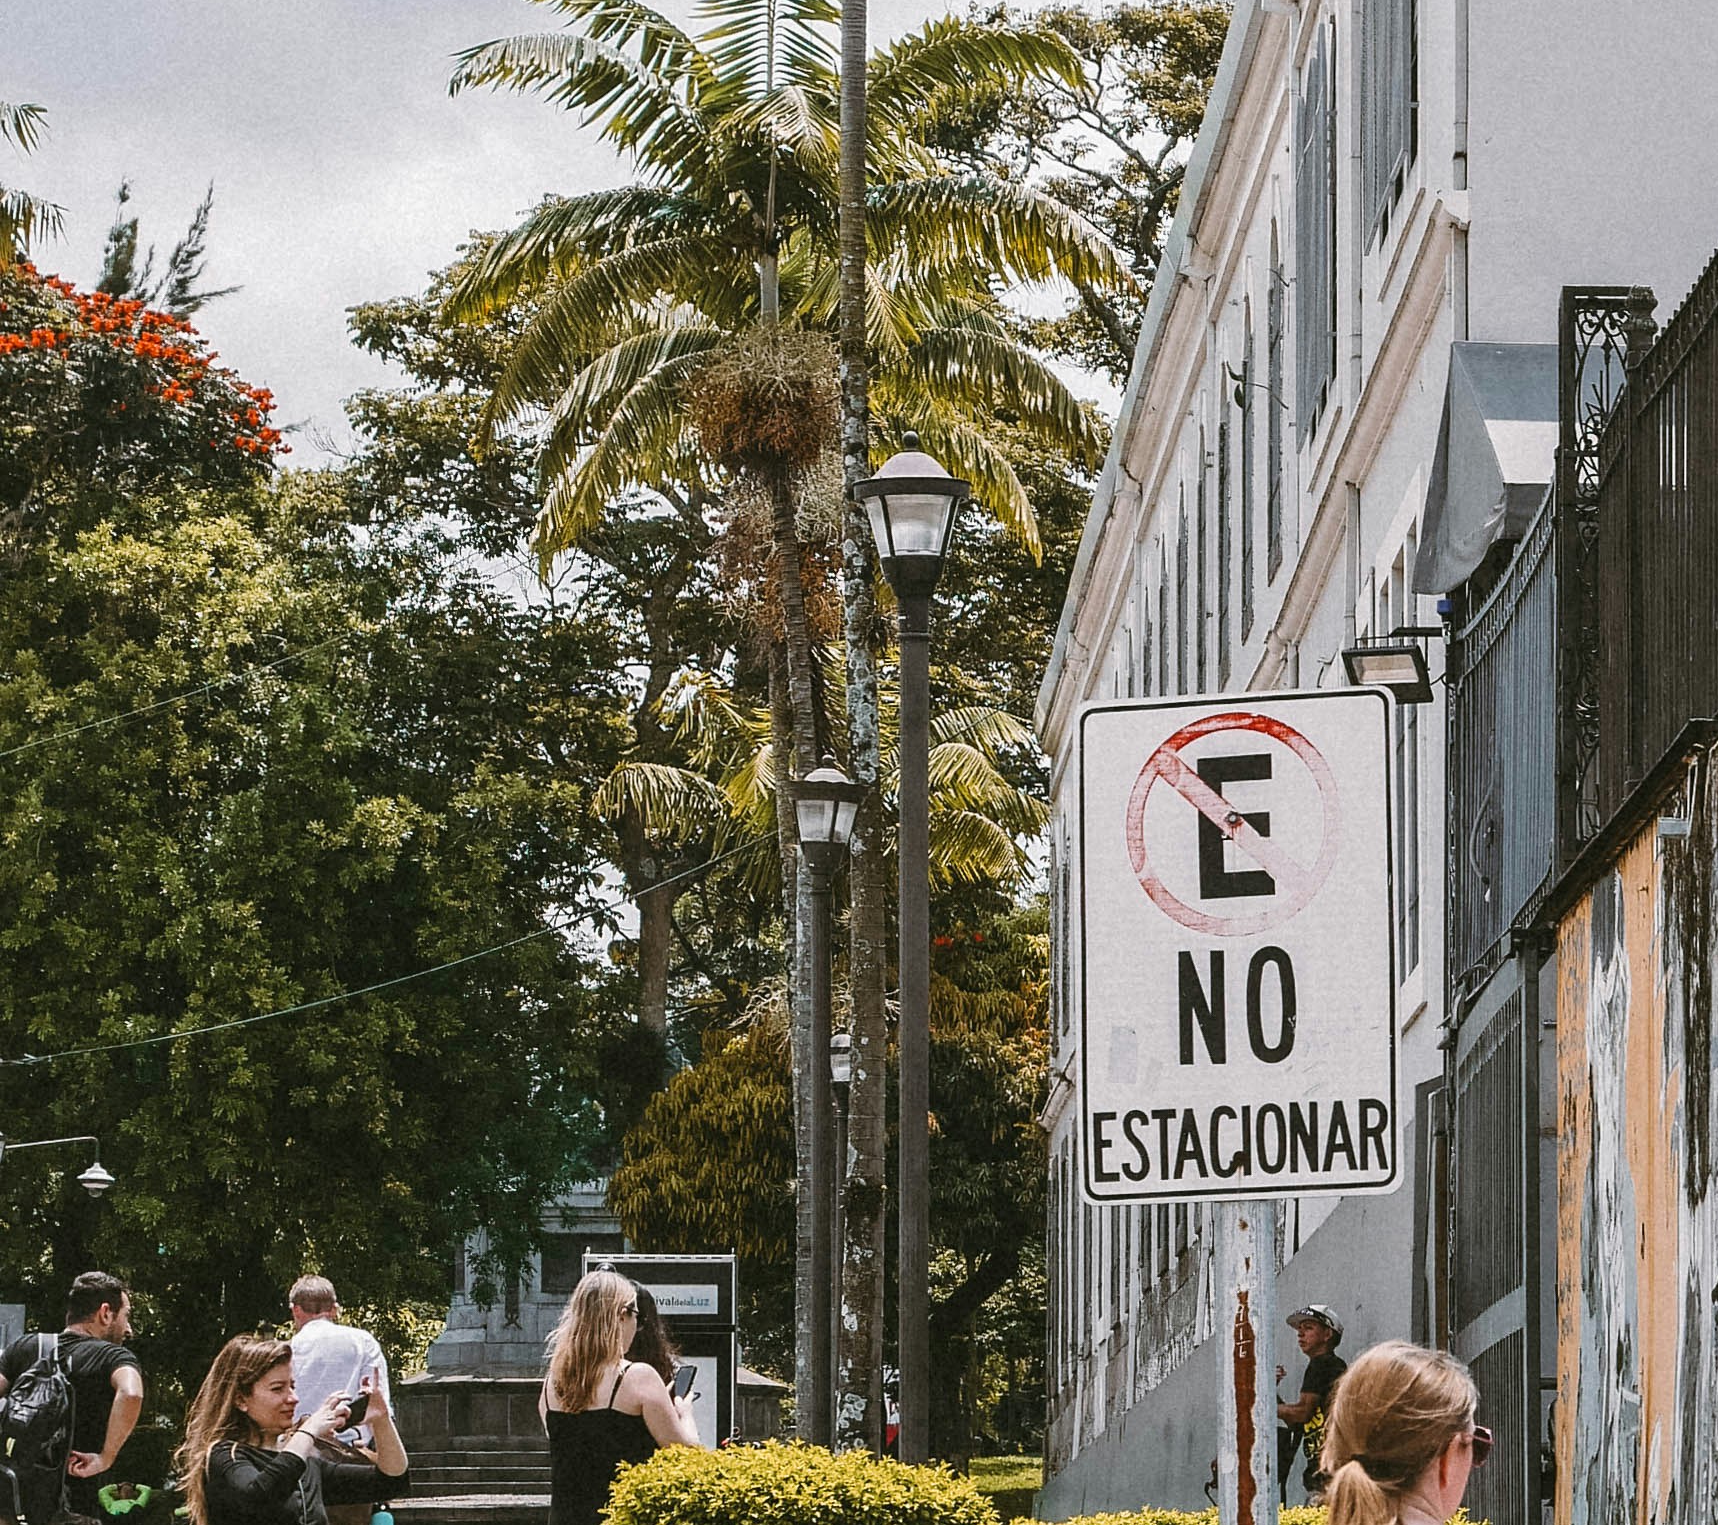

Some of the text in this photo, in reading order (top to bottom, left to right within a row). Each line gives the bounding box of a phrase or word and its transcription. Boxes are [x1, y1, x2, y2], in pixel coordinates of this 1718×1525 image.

[1197, 753, 1275, 899] E
[1178, 945, 1297, 1065] NO
[1094, 1098, 1388, 1183] ESTACIONAR
